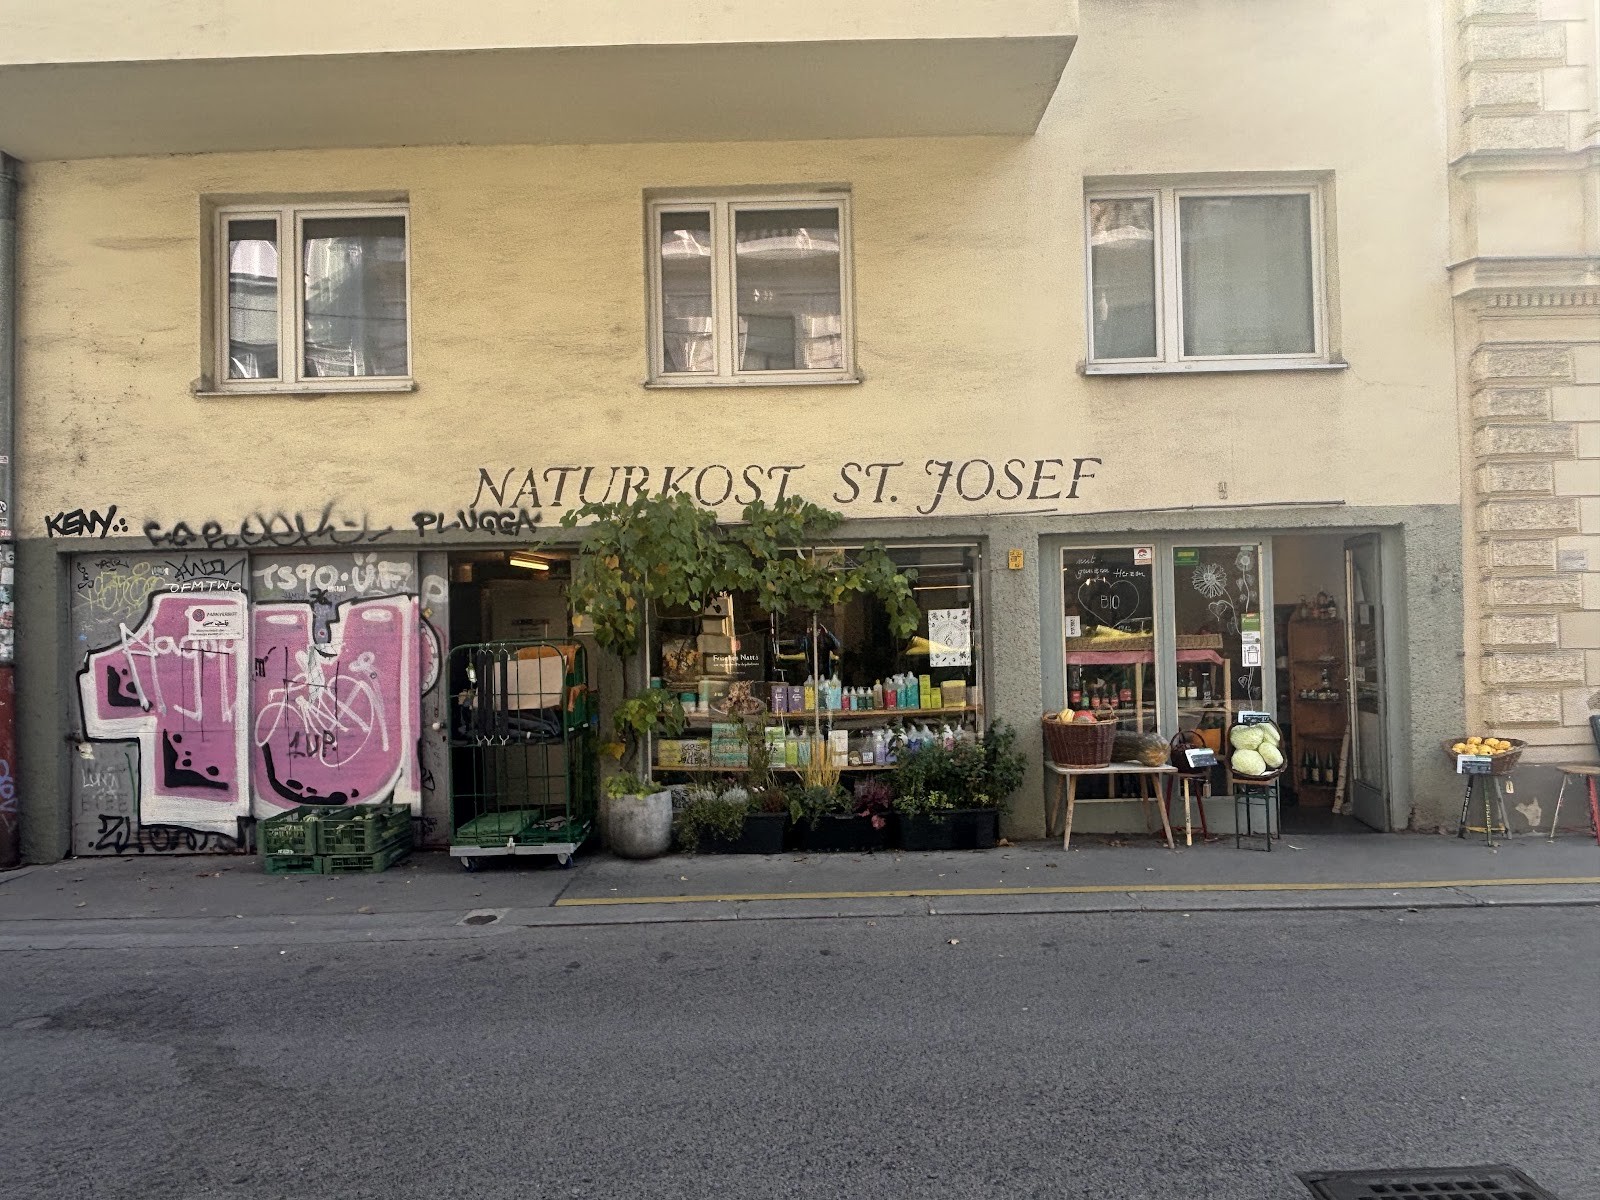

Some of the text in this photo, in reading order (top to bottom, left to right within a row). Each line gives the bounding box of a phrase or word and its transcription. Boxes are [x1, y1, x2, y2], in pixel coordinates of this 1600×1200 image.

[469, 457, 1103, 515] NATURKOST ST. JOSEF
[1101, 594, 1120, 610] BIO
